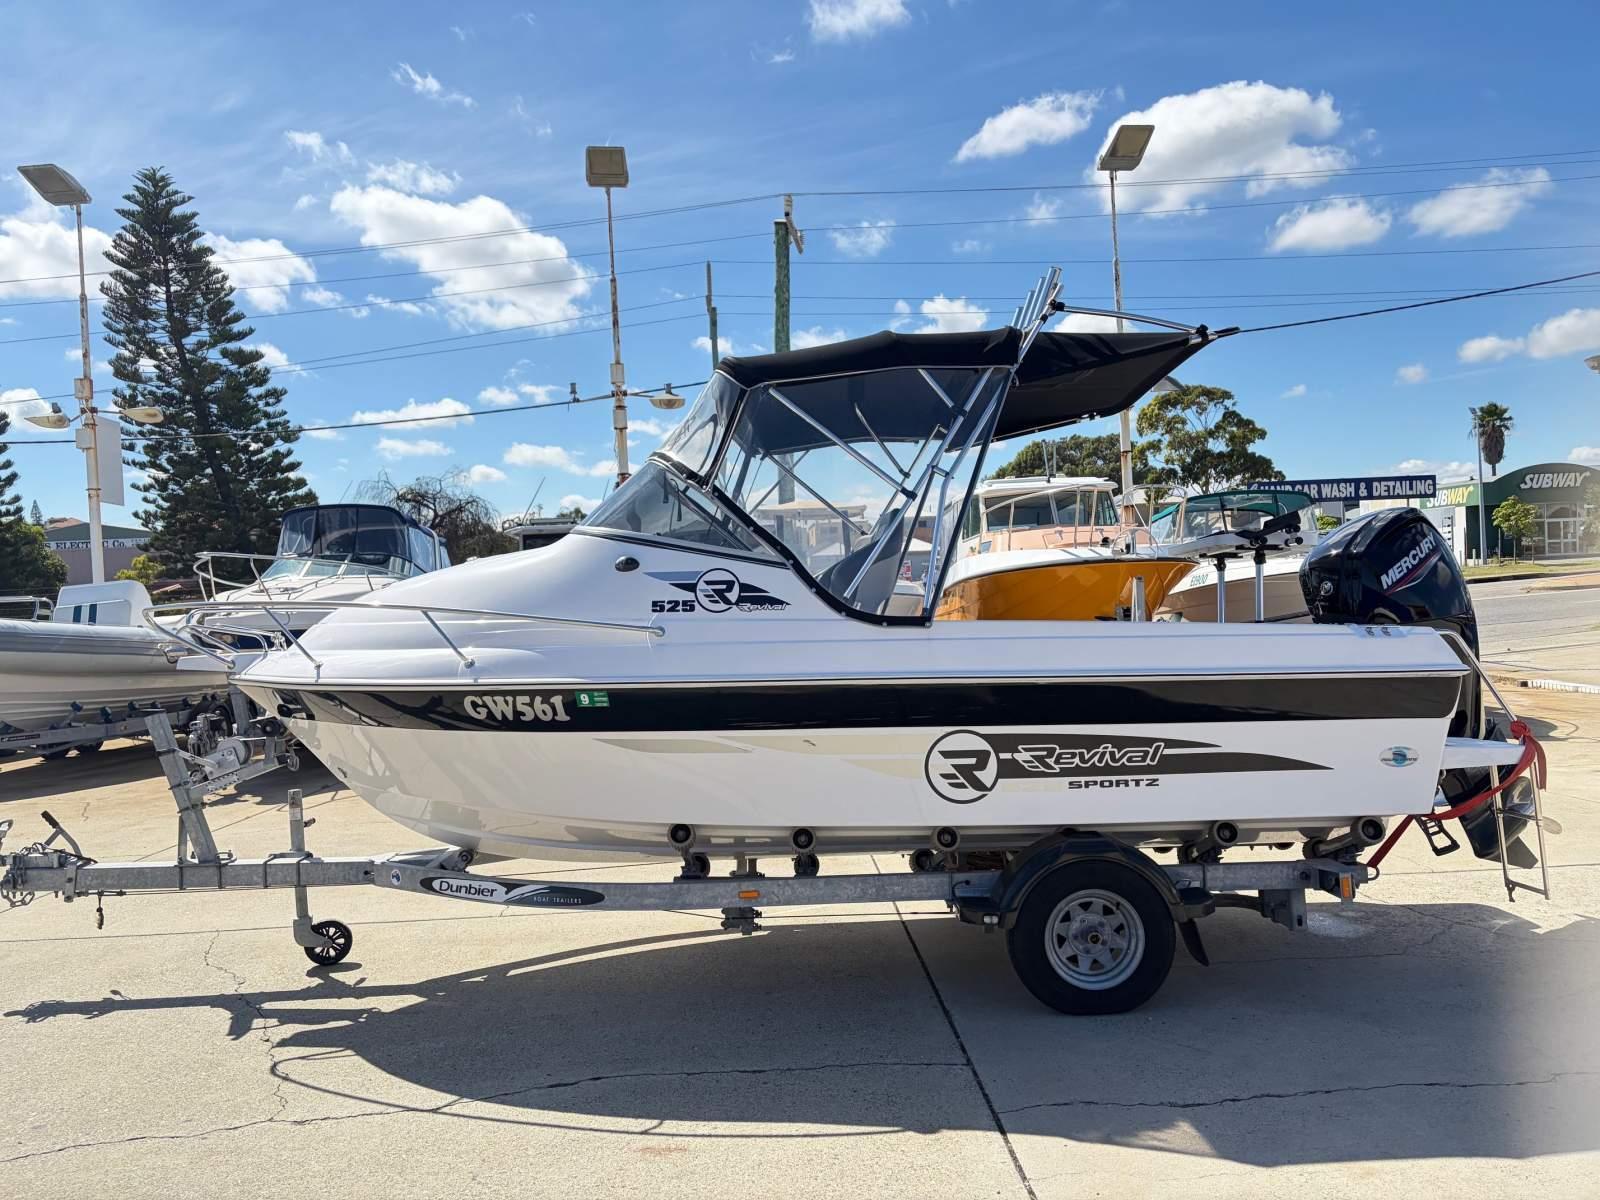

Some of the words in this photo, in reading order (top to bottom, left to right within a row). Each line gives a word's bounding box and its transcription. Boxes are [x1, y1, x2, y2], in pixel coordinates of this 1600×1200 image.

[1320, 482, 1355, 498] WASH
[1359, 482, 1368, 497] &
[1372, 479, 1434, 496] DETAILING
[1519, 472, 1591, 489] SUBWAY
[55, 541, 109, 549] ELECTC
[1380, 533, 1437, 590] MERCURY
[651, 599, 696, 613] 525
[736, 603, 788, 613] Revival
[579, 693, 590, 705] 9
[463, 695, 571, 722] GW561
[1011, 742, 1165, 773] Revival
[1067, 778, 1160, 790] SPORTZ
[439, 879, 498, 898] Dunbier
